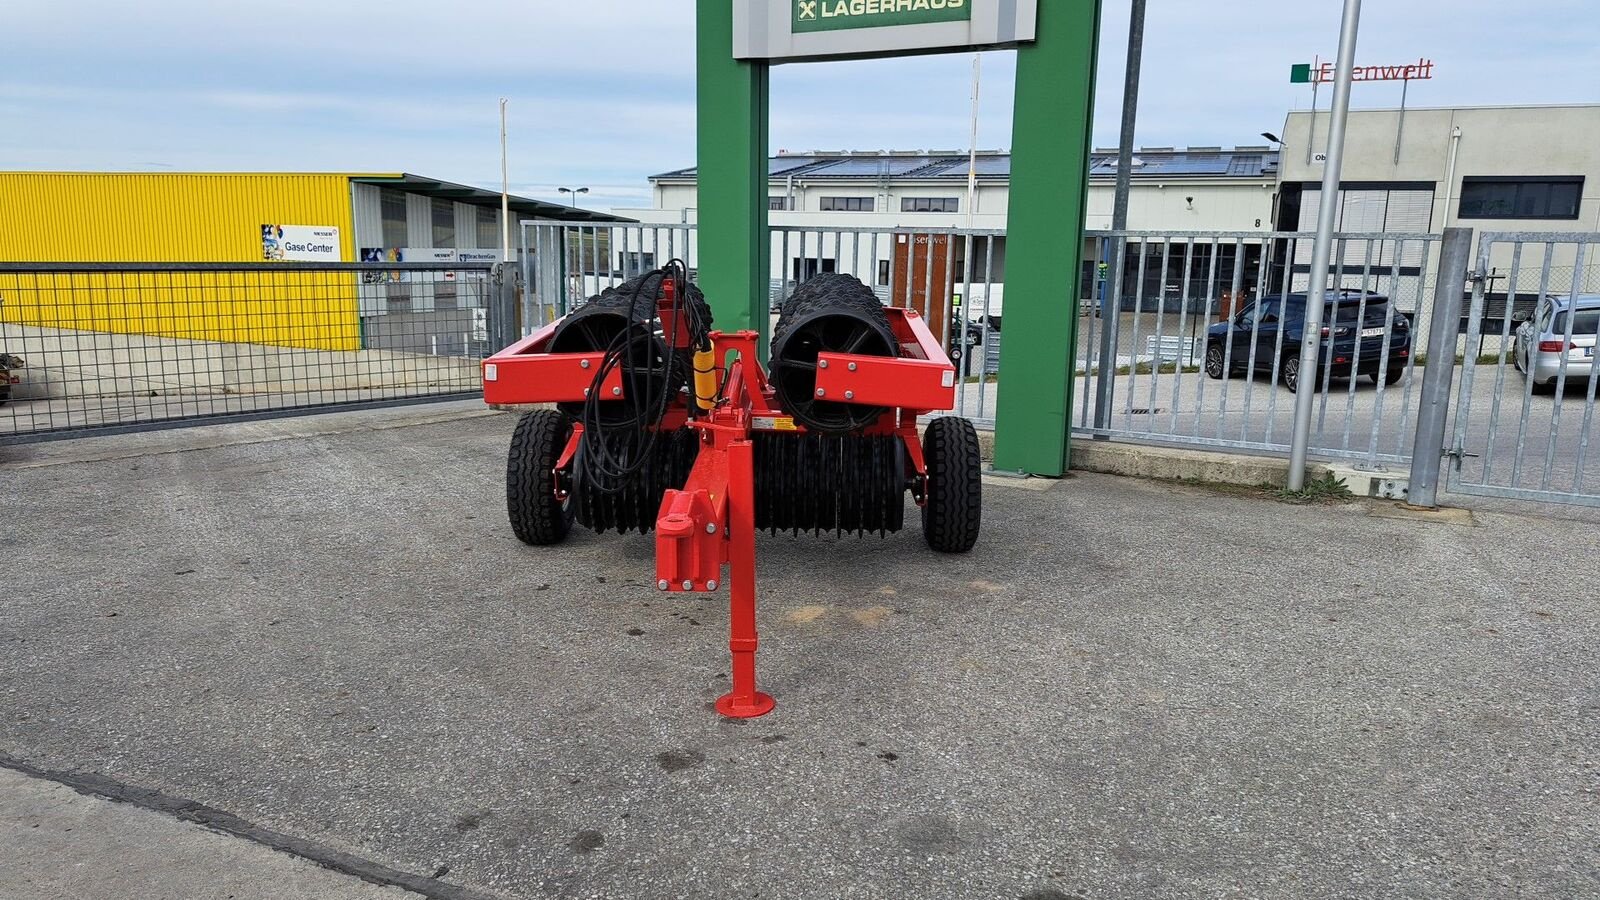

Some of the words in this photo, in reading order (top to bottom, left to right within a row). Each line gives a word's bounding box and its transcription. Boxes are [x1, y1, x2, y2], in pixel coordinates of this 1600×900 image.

[1320, 58, 1433, 82] Eenwelt
[1255, 218, 1261, 227] 8
[285, 242, 305, 252] Gase
[306, 243, 334, 253] Center
